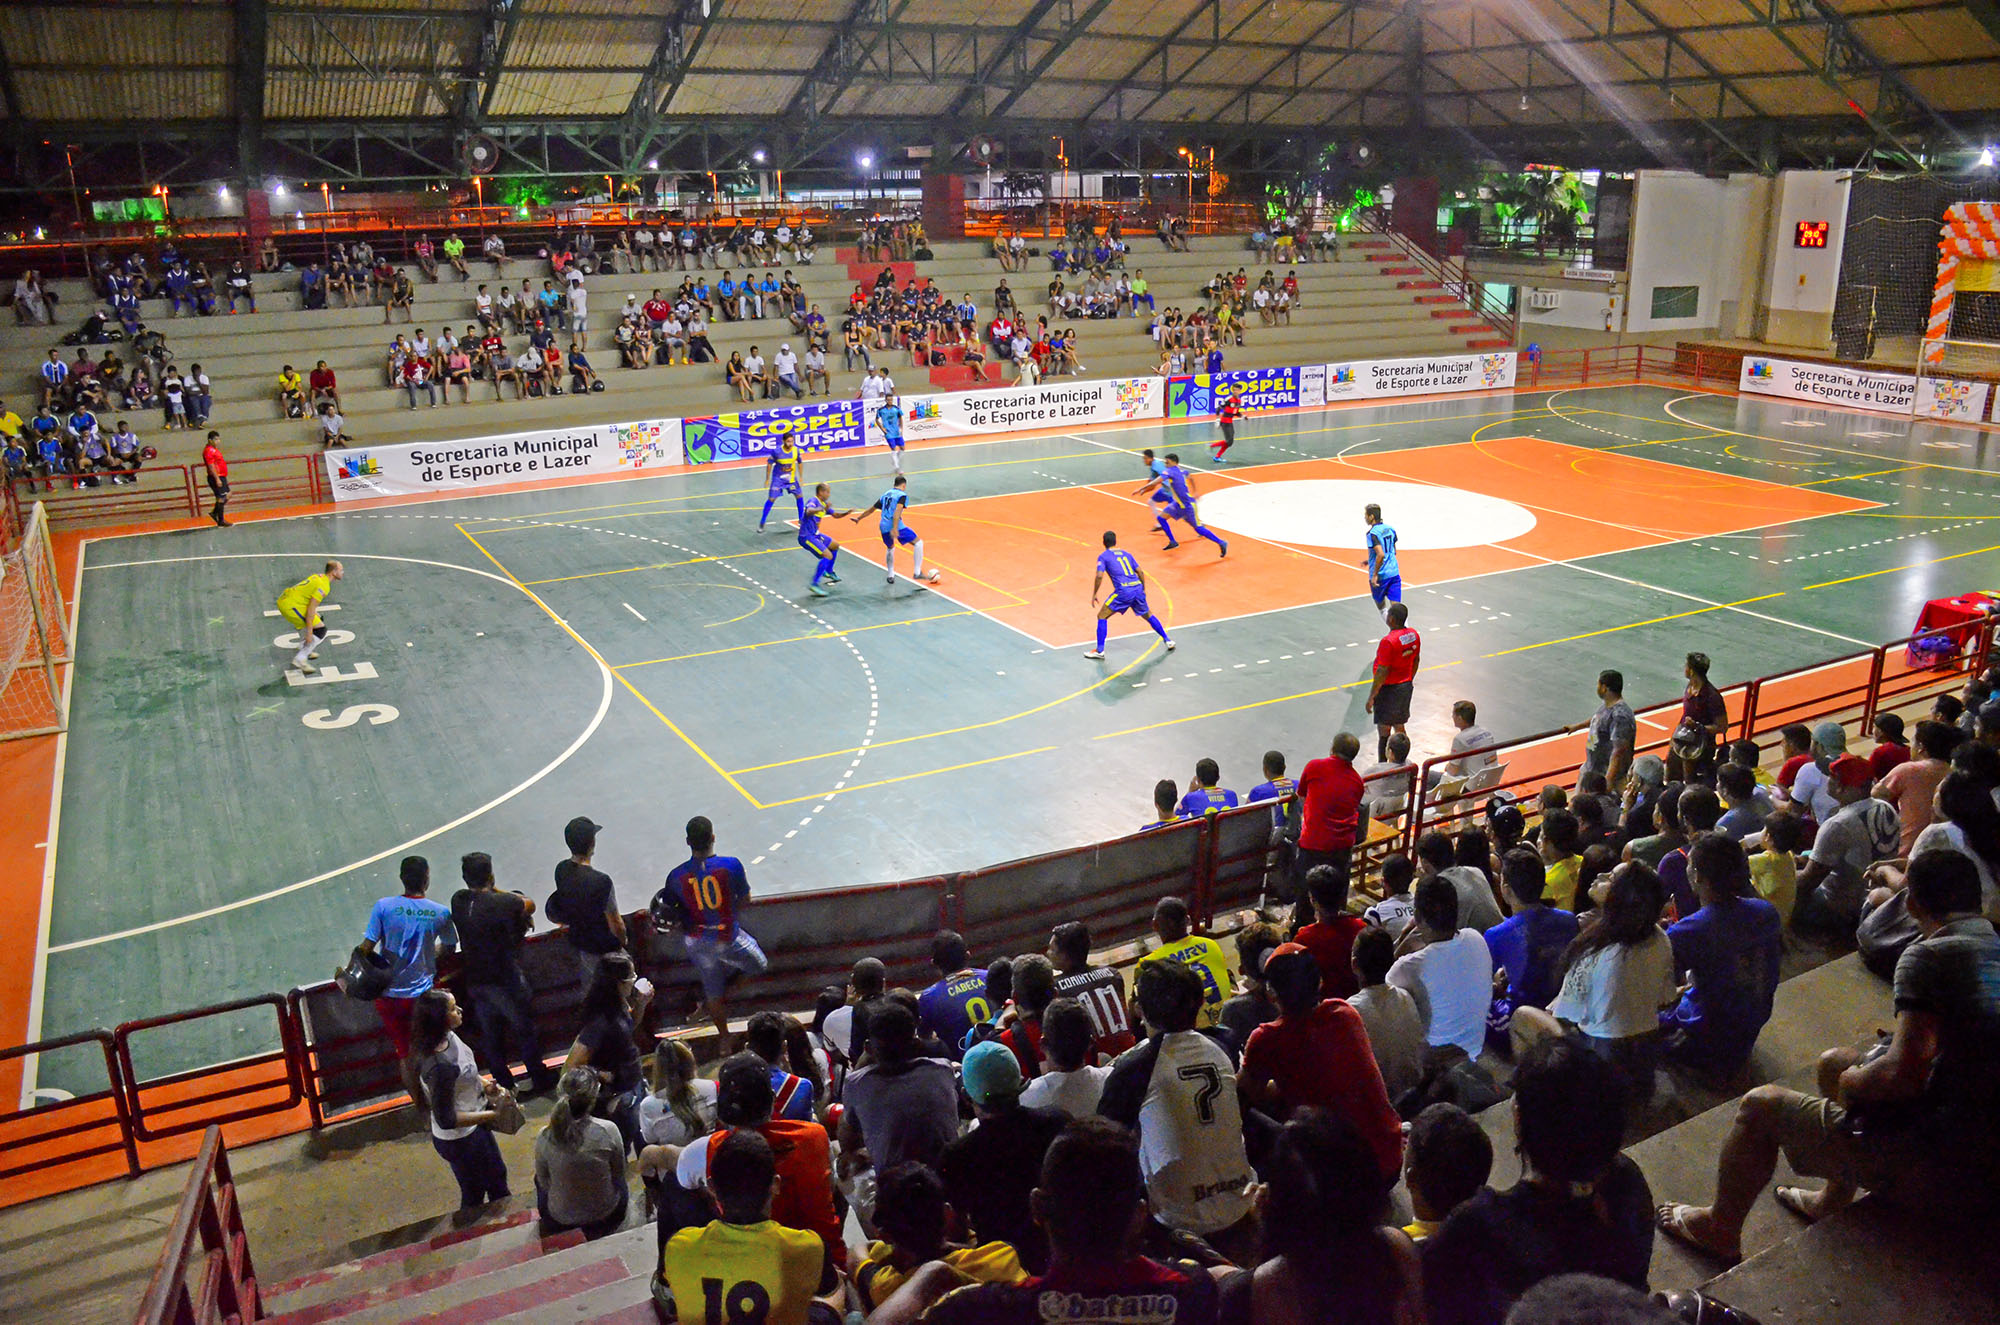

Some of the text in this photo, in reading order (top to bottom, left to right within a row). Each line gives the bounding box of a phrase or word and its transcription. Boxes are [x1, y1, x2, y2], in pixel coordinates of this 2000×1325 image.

[1371, 361, 1473, 377] Secretaria Municipal
[1791, 367, 1918, 393] Secretaria Municipa
[1214, 377, 1296, 396] GOSPEL
[1375, 379, 1388, 390] de
[1391, 377, 1430, 391] Esporte
[1441, 374, 1468, 385] Lazer
[1794, 379, 1913, 406] de Esporte e Lazer
[963, 387, 1103, 412] Secretaria Municipal
[1240, 391, 1296, 407] FUTSAL
[747, 412, 859, 437] GOSPEL
[970, 402, 1097, 426] de Esporte e Lazer
[410, 433, 600, 467] Secretaria Municipal
[748, 437, 777, 452] DE
[795, 428, 860, 446] UTSAL
[422, 452, 592, 483] de Esporte e Lazer
[1117, 556, 1134, 577] 11
[688, 876, 722, 910] 10
[947, 977, 986, 997] CABEÇA
[1077, 984, 1128, 1038] 10
[1177, 1062, 1222, 1124] 7
